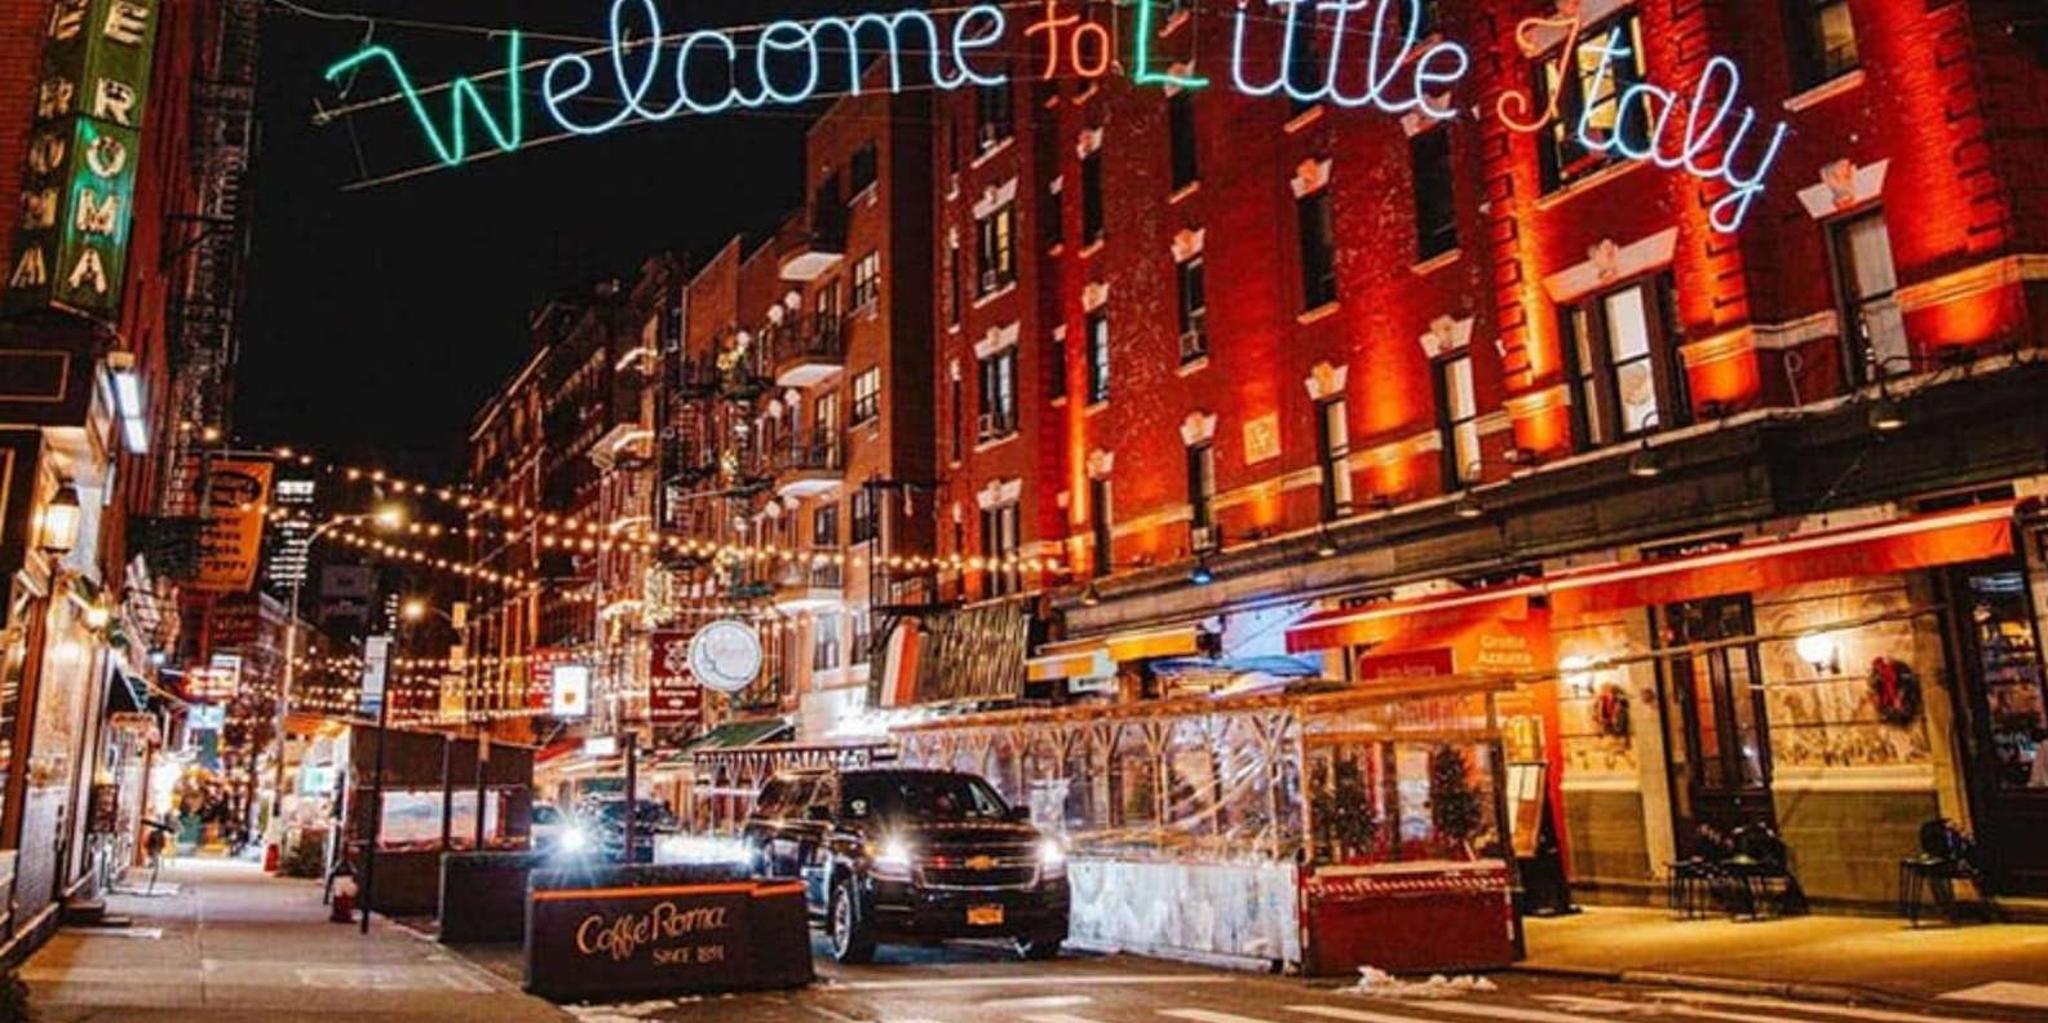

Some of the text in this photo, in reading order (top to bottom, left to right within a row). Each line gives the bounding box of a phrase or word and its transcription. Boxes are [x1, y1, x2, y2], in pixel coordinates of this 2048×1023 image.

[69, 77, 136, 294] ROMA
[325, 0, 1788, 233] Welcome to Little Italy
[651, 902, 728, 940] Roma
